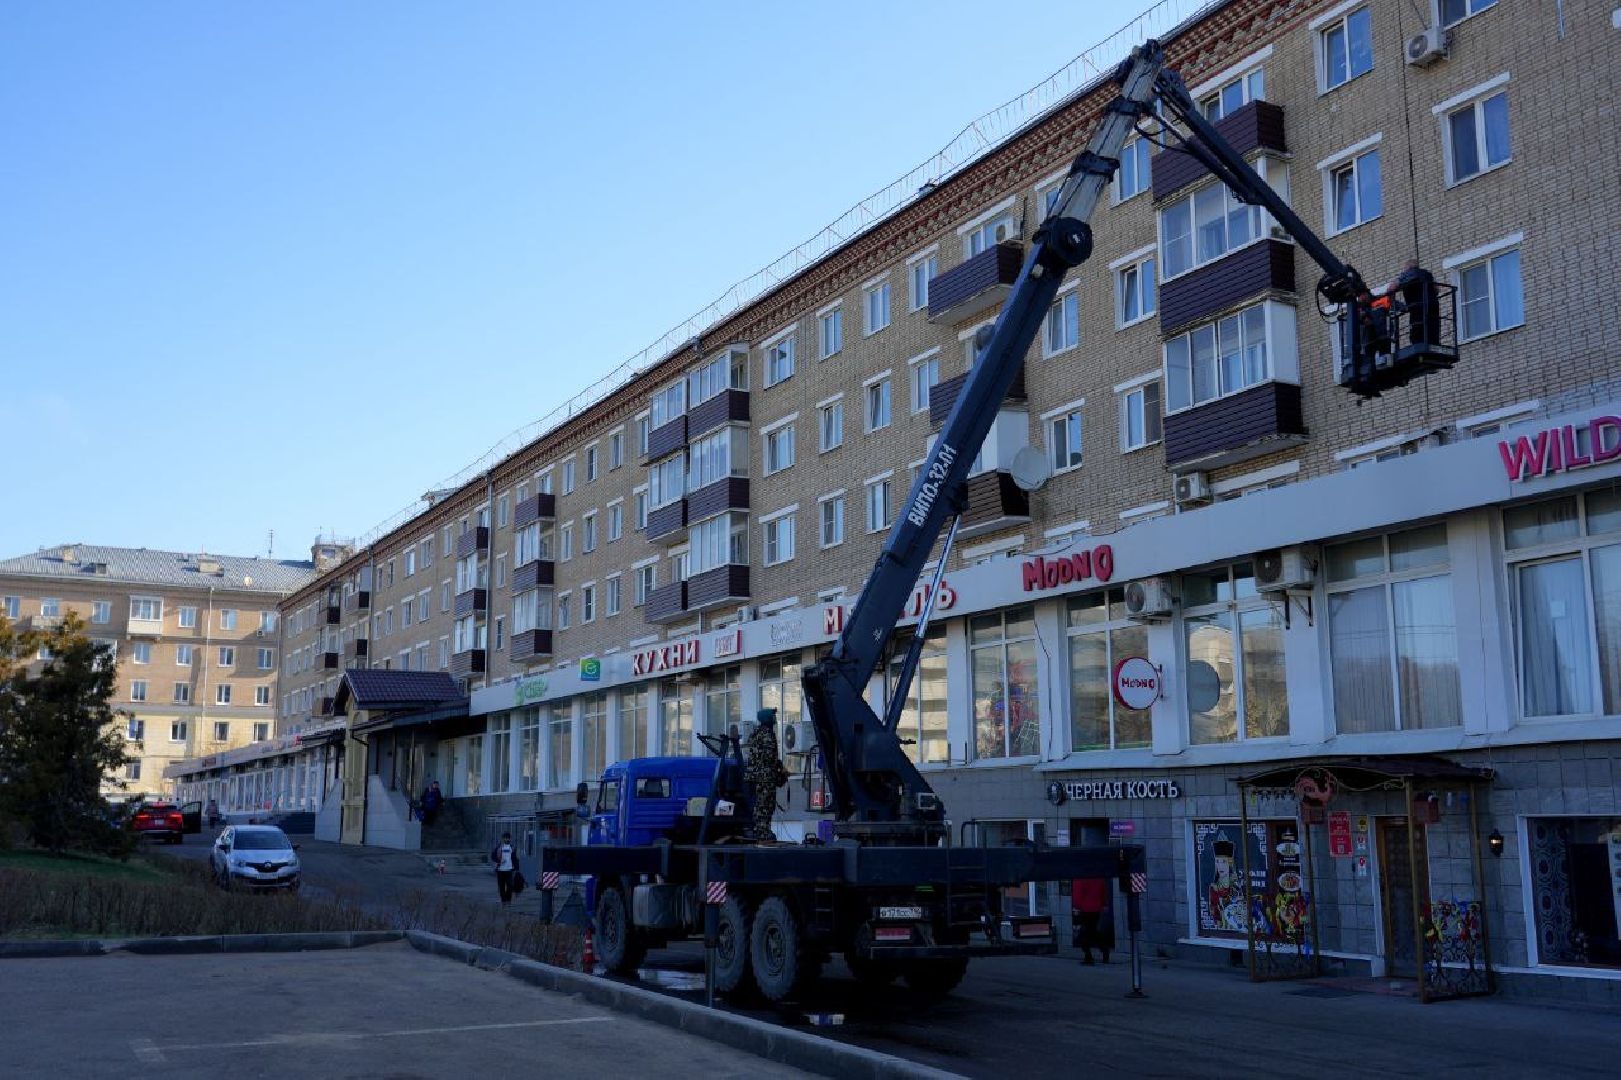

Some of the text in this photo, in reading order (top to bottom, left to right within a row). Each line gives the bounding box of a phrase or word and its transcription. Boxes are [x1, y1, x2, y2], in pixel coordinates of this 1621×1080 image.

[1498, 416, 1621, 482] WILD
[824, 581, 957, 635] МЛЬ
[633, 640, 700, 677] КУХНИ
[1065, 780, 1180, 801] ЧЕРНАЯ КОСТЬ
